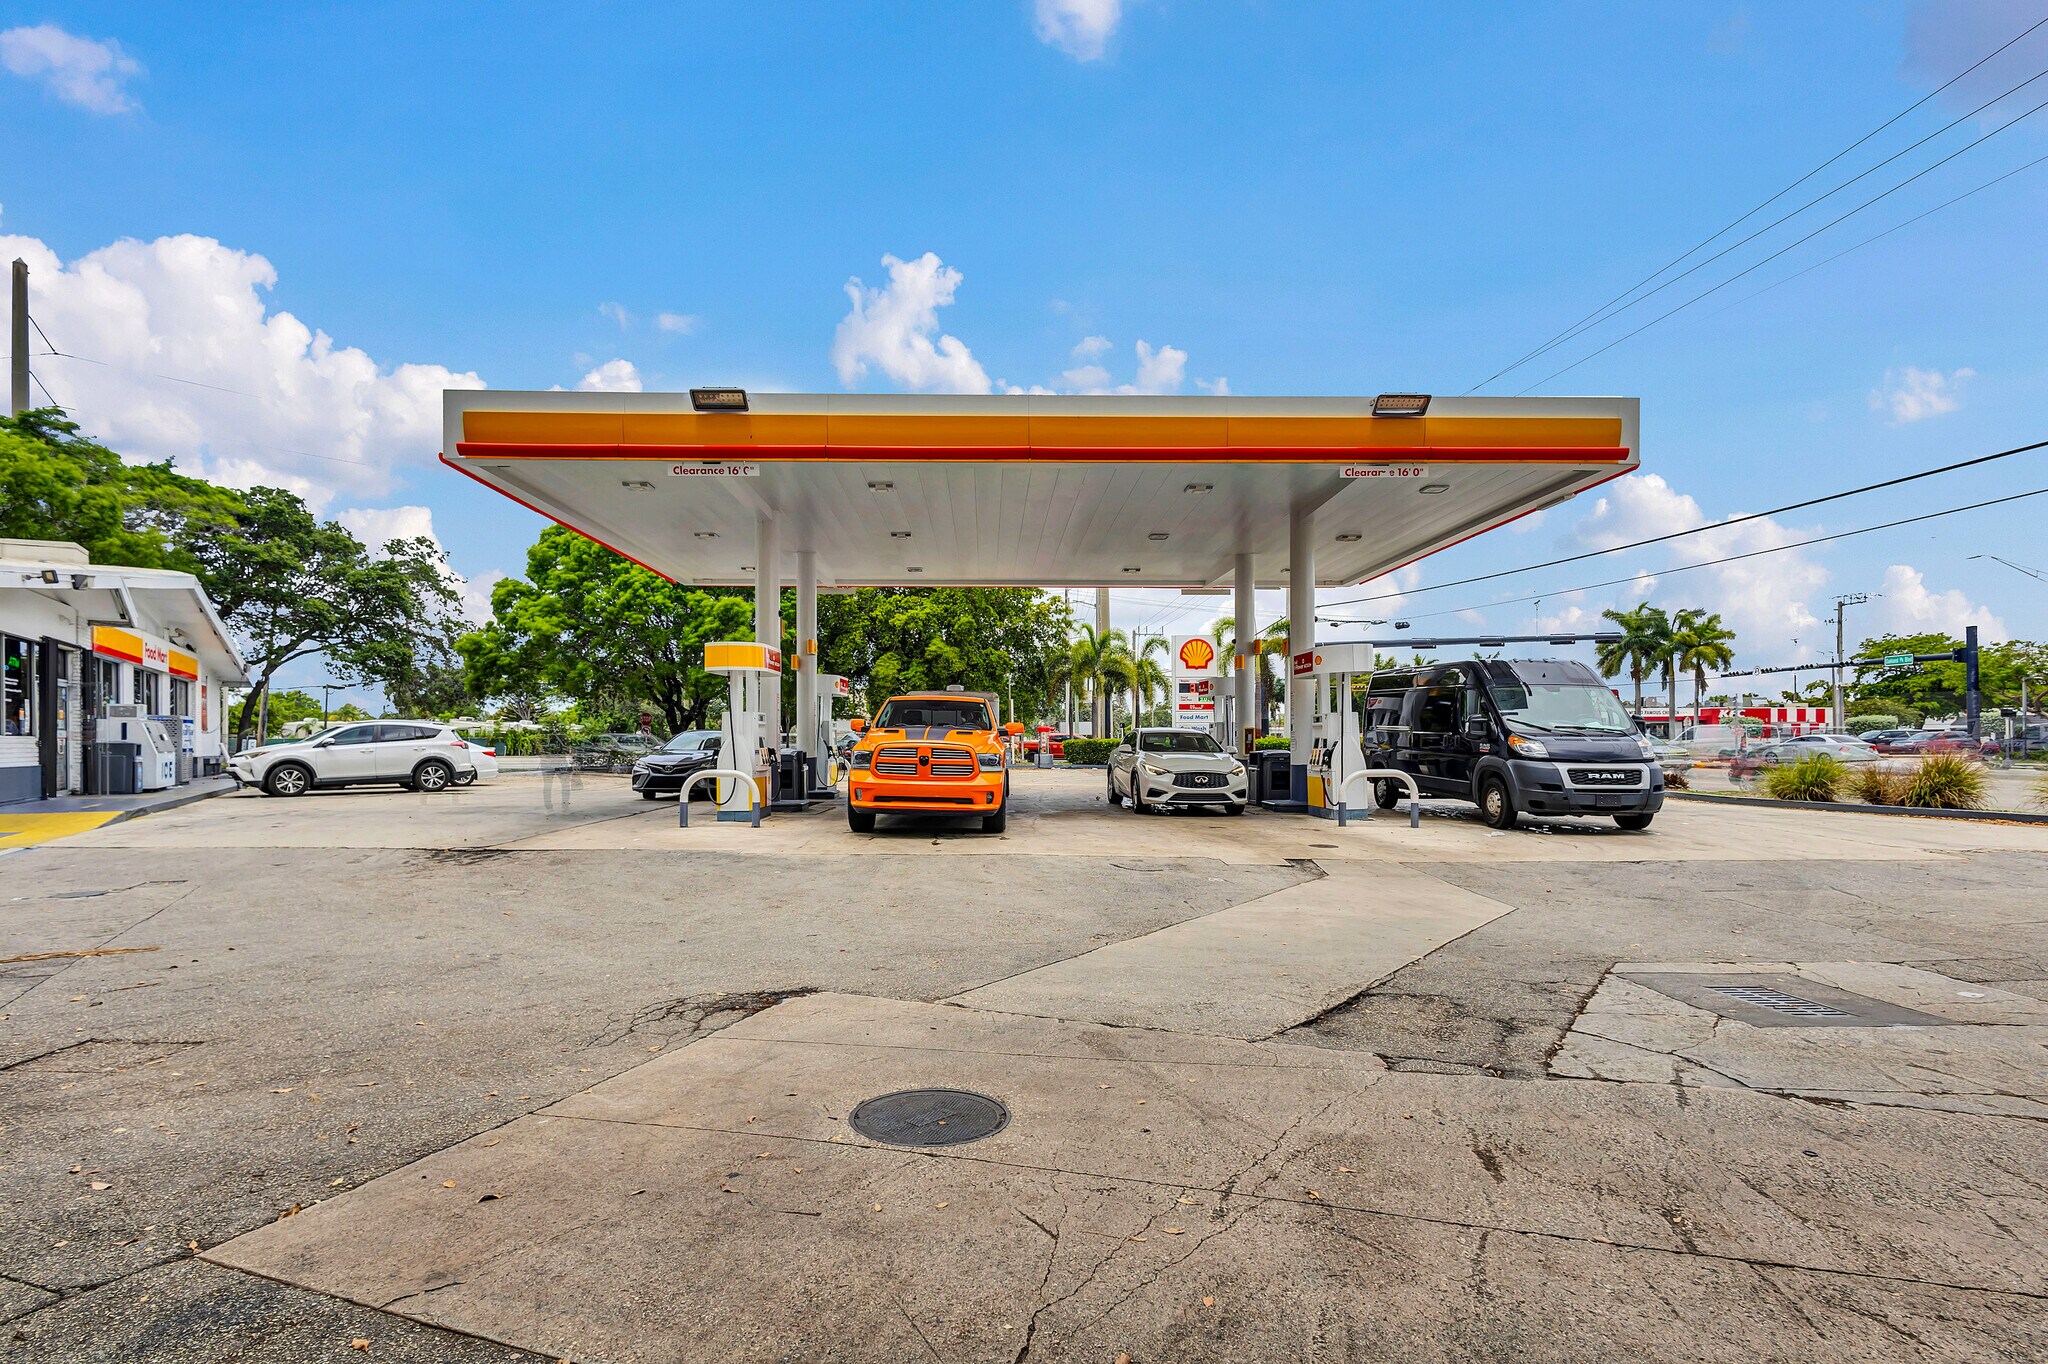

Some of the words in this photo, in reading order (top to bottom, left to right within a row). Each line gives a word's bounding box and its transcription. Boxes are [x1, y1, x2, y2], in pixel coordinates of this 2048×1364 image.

[673, 466, 725, 475] Clearance
[727, 466, 741, 475] 16'
[1398, 468, 1411, 477] 16'
[1413, 468, 1424, 477] 0"
[144, 642, 157, 661] Food
